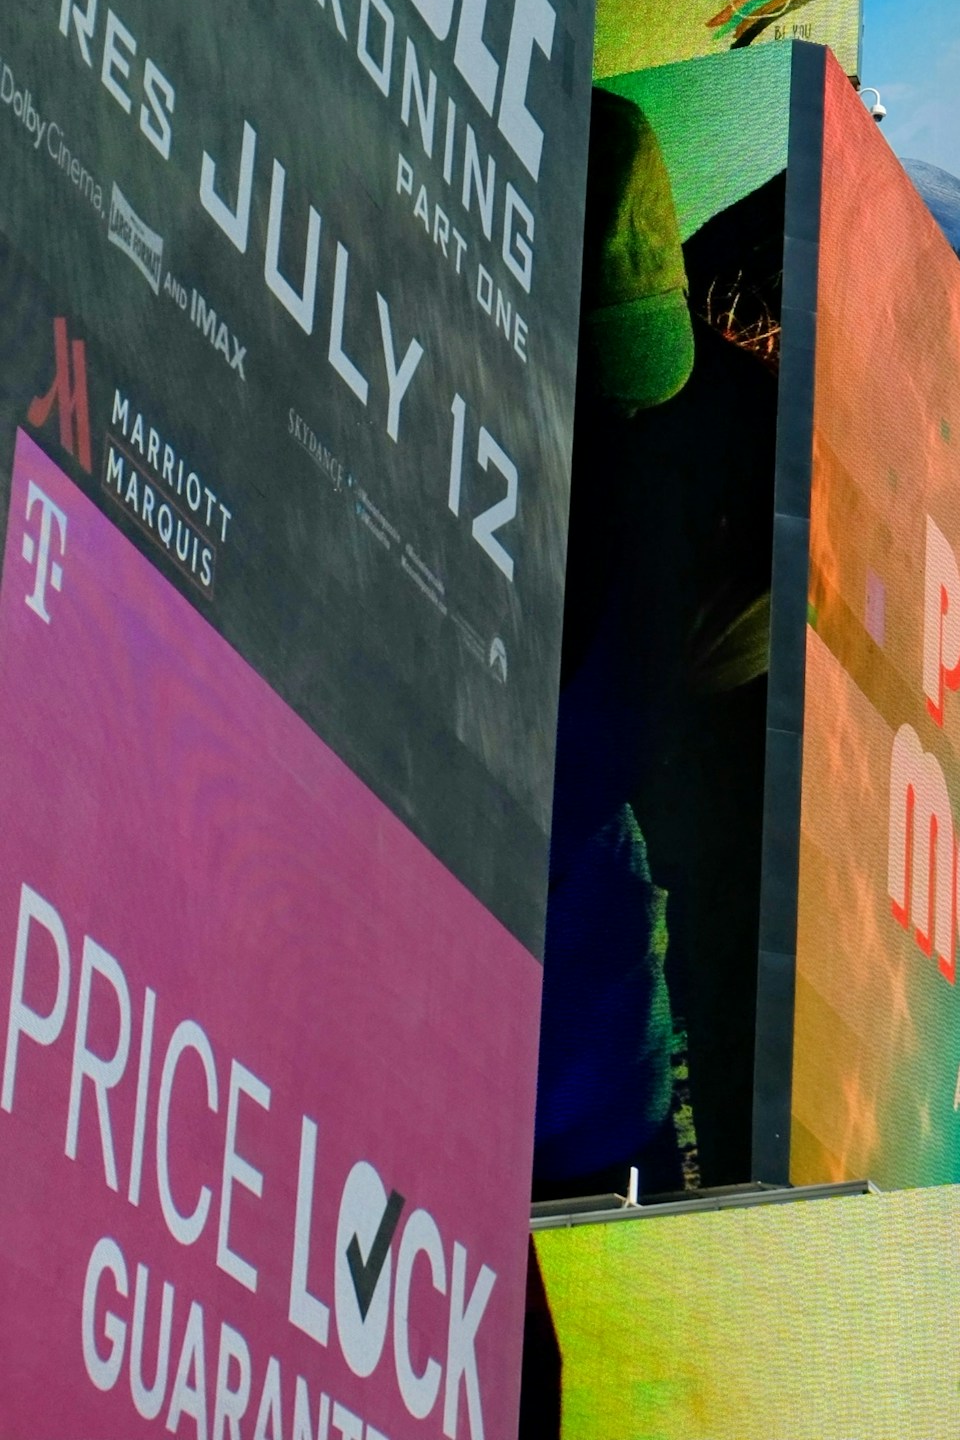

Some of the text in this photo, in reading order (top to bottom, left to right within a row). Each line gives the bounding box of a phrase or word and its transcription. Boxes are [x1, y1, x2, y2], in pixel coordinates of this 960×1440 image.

[1, 63, 46, 149] Dolby
[163, 271, 188, 310] AND
[190, 288, 247, 382] IMAX
[396, 153, 528, 363] PART ONE
[200, 120, 423, 443] JULY
[448, 393, 519, 582] 12
[287, 407, 344, 489] SKYDANCE
[106, 447, 213, 587] MARQUIS
[112, 388, 232, 543] MARRIOTT
[0, 882, 271, 1293] PRICE
[81, 1235, 391, 1440] GUARAN
